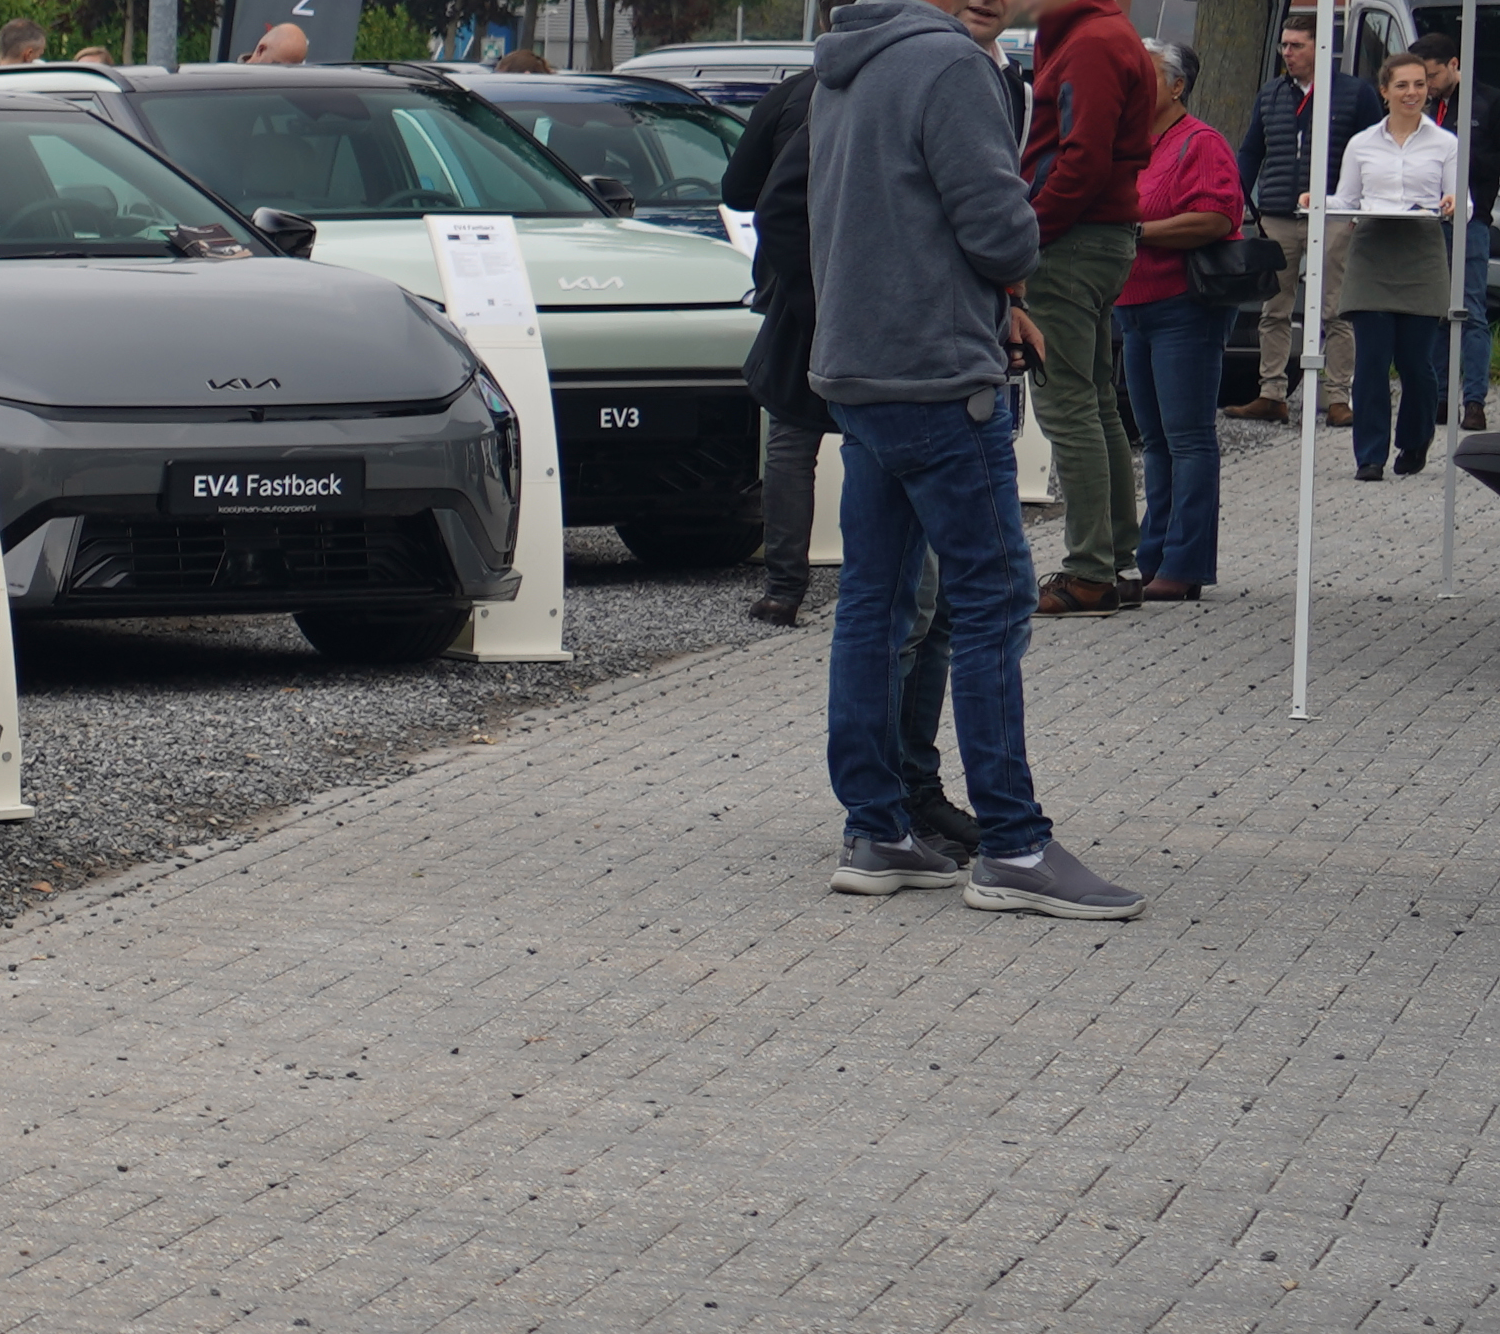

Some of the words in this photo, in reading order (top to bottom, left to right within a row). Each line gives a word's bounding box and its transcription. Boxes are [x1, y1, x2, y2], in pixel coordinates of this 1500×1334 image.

[558, 276, 624, 291] KIA
[206, 378, 281, 391] KIA
[600, 407, 640, 428] EV3
[194, 474, 240, 497] EV4
[246, 473, 342, 496] Fastback
